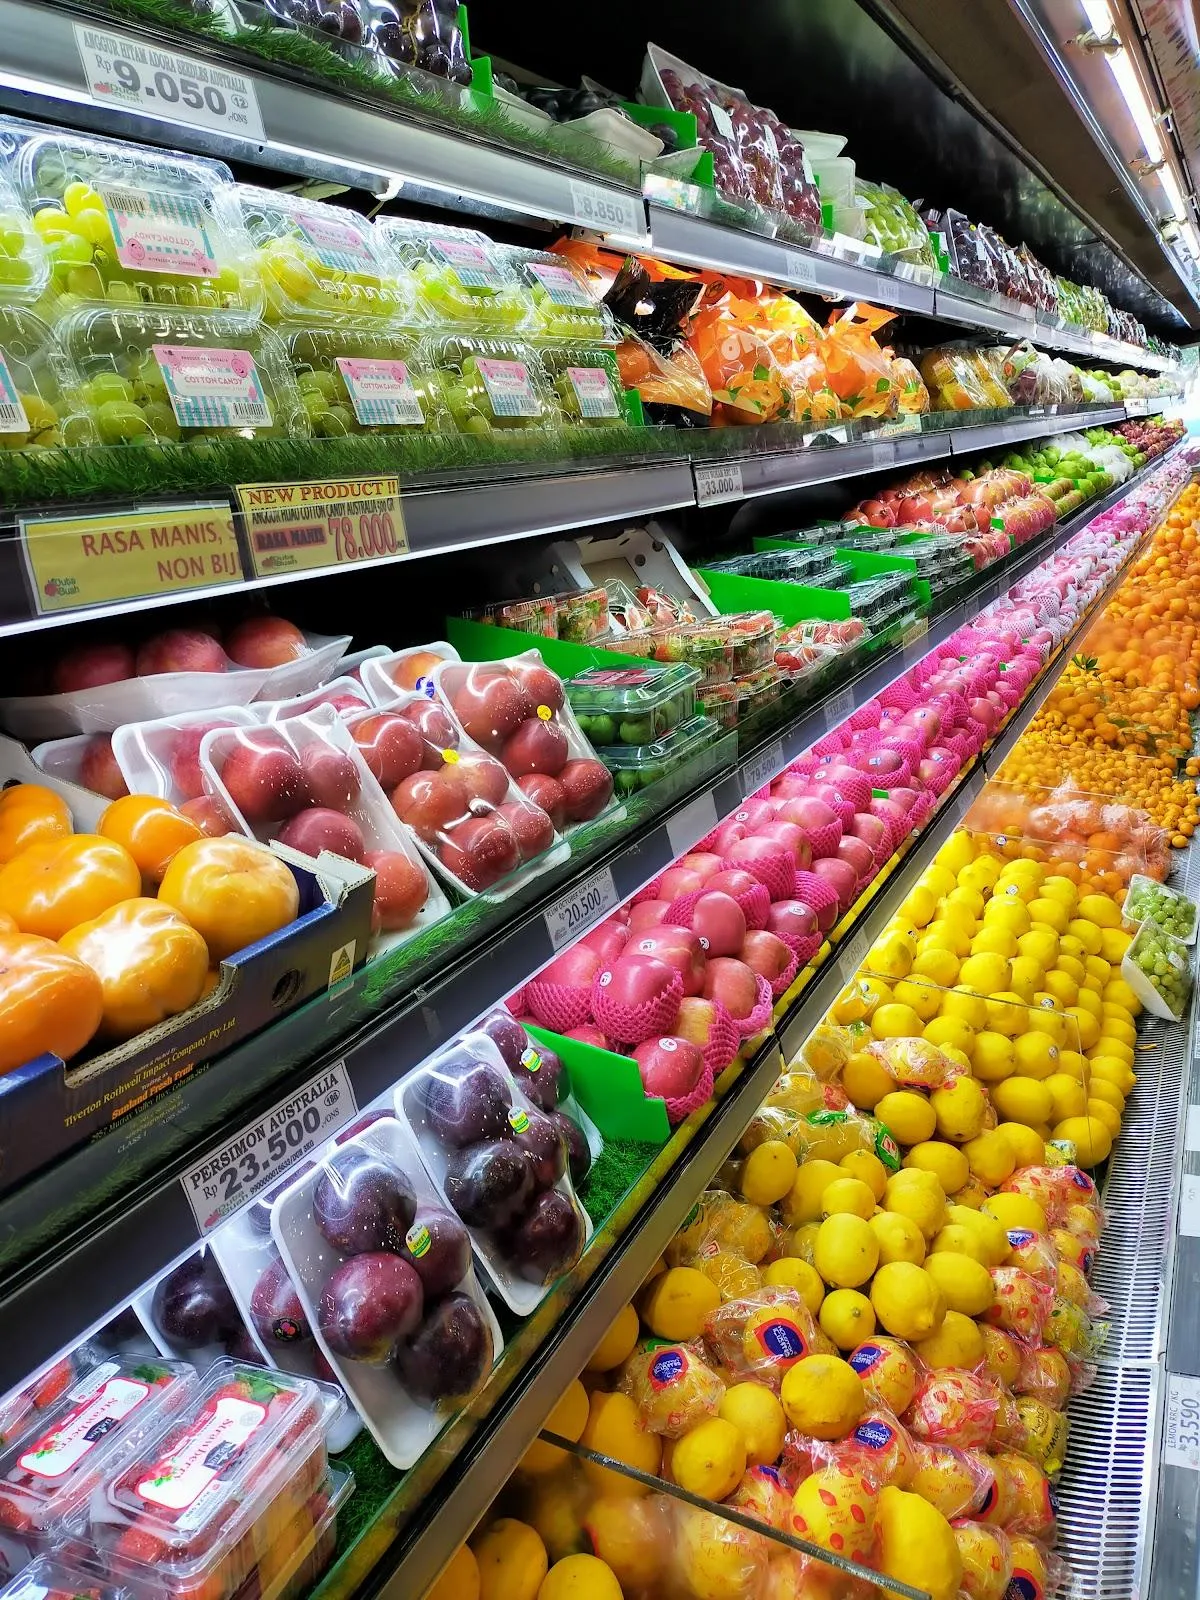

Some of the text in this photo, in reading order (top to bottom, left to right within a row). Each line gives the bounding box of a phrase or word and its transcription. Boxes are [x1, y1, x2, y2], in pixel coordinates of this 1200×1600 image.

[83, 31, 117, 56] ANGGUR
[119, 41, 148, 65] HITAM
[149, 51, 177, 73] ADORA
[209, 70, 247, 94] AUSTRALIA
[95, 53, 227, 116] Rp 9.050
[582, 196, 624, 224] 8.850
[184, 376, 244, 386] COTTON CANDY
[247, 487, 295, 505] NEW
[300, 481, 384, 501] PRODUCT
[705, 478, 734, 496] 33.000
[301, 504, 327, 520] COTTON
[327, 502, 347, 518] CANDY
[347, 499, 377, 516] AUSTRALIA
[82, 529, 145, 557] RASA
[151, 521, 223, 549] MANIS,
[328, 512, 397, 562] 78.000
[157, 556, 205, 582] NON
[565, 888, 601, 928] 20.500
[64, 1099, 102, 1128] Tiverton
[103, 1073, 142, 1103] Rothwell
[142, 1058, 172, 1081] Impact
[172, 1036, 208, 1062] Company
[208, 1028, 222, 1042] Pty
[222, 1017, 237, 1032] Ltd
[111, 1089, 150, 1121] Sunland
[149, 1074, 174, 1098] Fresh
[173, 1062, 195, 1083] Fruit
[190, 1073, 340, 1191] PERSIMON AUSTRALIA
[202, 1184, 218, 1200] Rp
[219, 1106, 322, 1201] 23.500
[54, 1397, 119, 1453] Strawberry
[1169, 1407, 1178, 1421] RRC
[1180, 1398, 1200, 1447] 3.590
[174, 1418, 235, 1480] Strawberry
[1042, 1424, 1061, 1459] LEMON
[1167, 1422, 1178, 1449] LEMON
